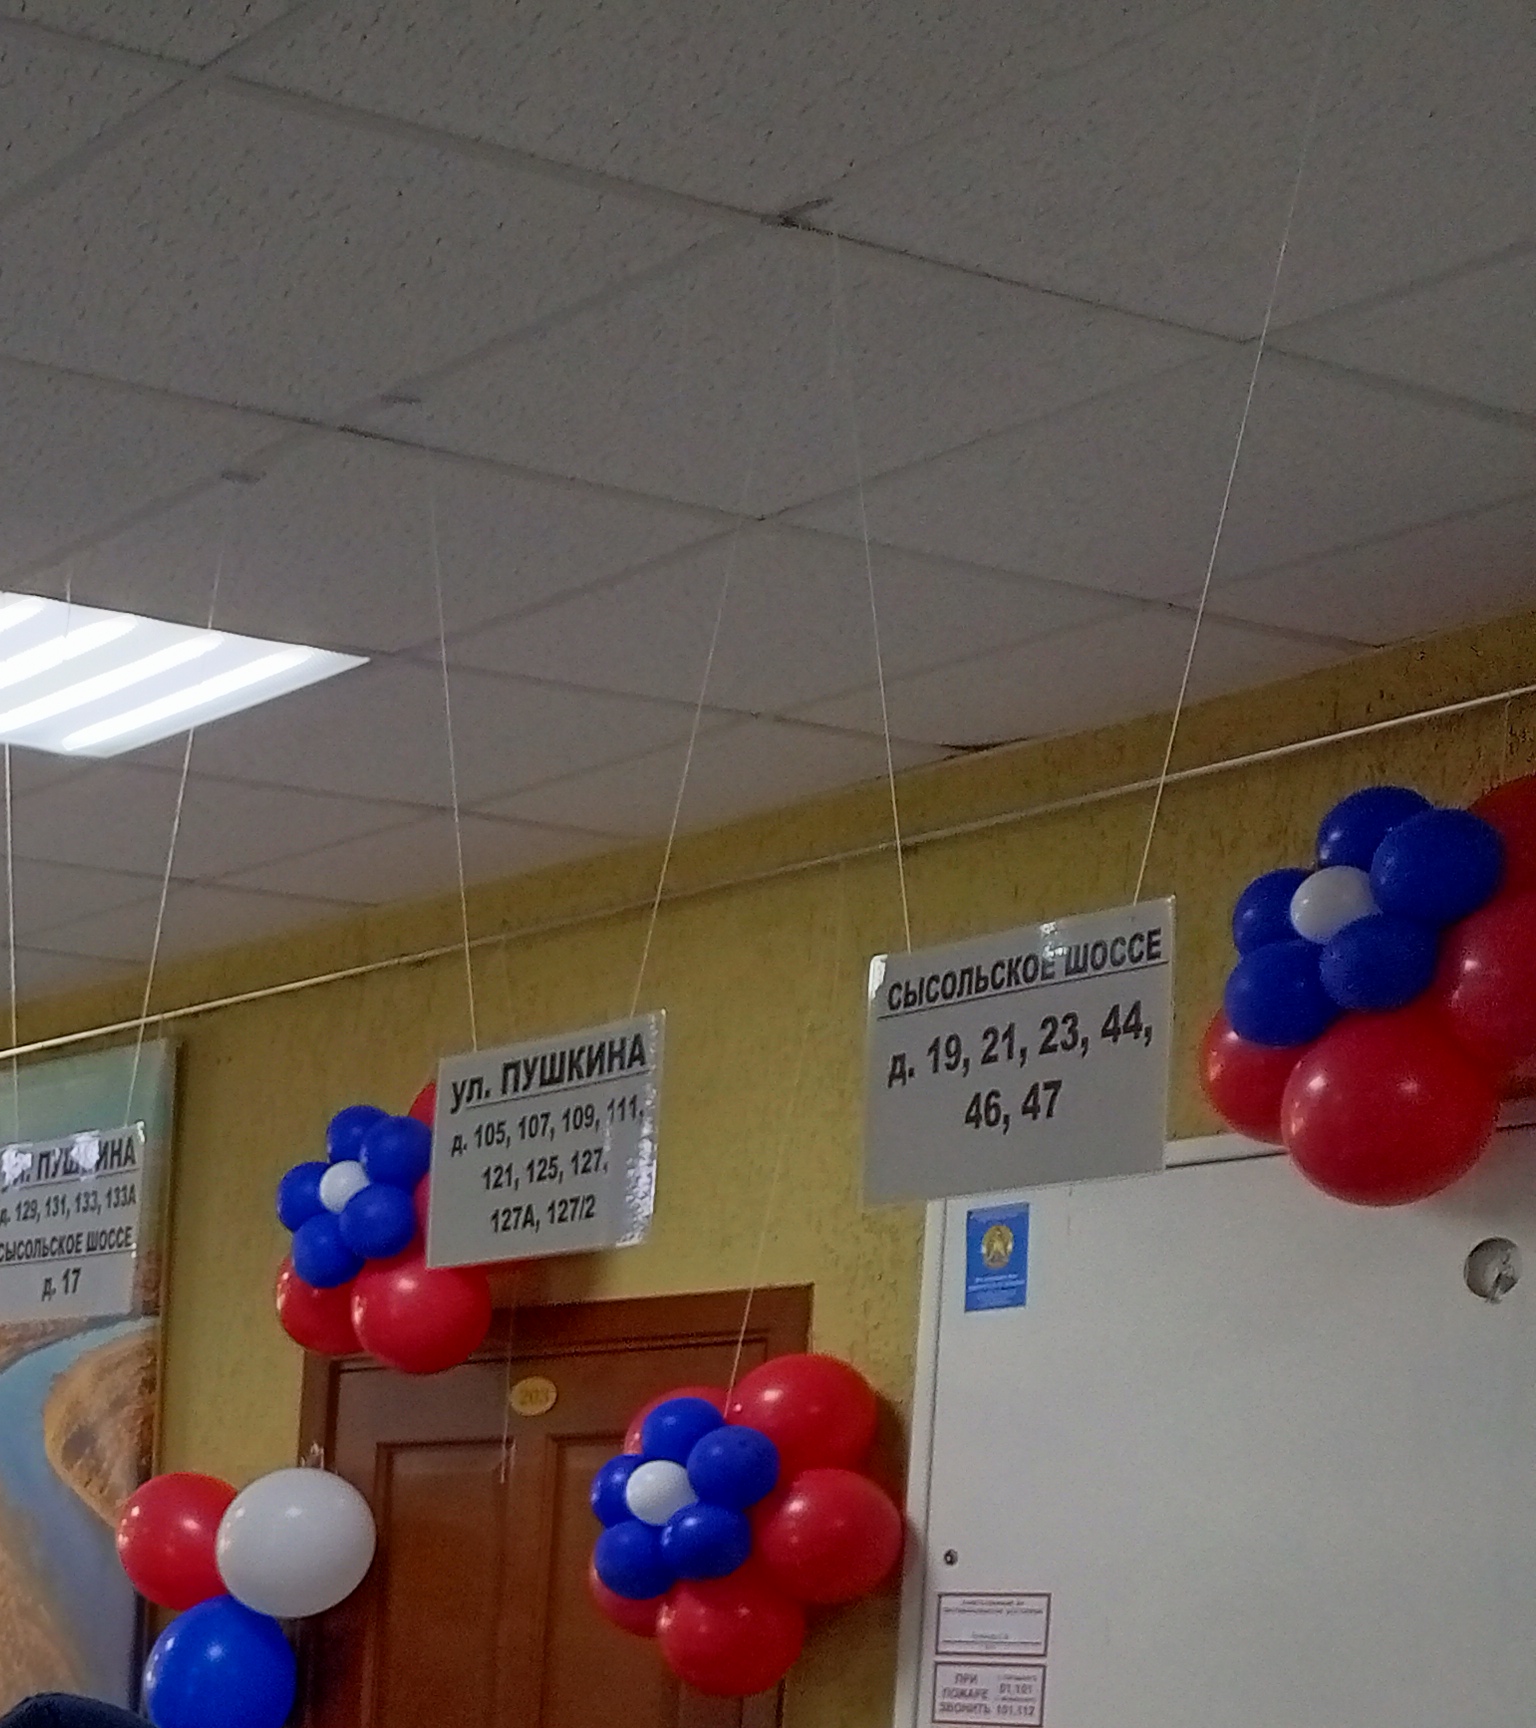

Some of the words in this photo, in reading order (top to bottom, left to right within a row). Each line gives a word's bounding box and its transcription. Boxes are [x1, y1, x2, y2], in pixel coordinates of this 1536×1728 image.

[886, 952, 1056, 1012] СЫСОЛЬСКОЕ
[1065, 926, 1163, 977] ШОССЕ
[501, 1032, 647, 1095] ПУШКИНА
[886, 1055, 916, 1089] д.
[927, 1033, 971, 1078] 19,
[981, 1022, 1028, 1069] 21,
[1039, 1011, 1090, 1058] 23,
[1101, 1000, 1154, 1047] 44,
[474, 1120, 512, 1149] 105,
[518, 1112, 556, 1141] 107,
[562, 1103, 600, 1132] 109,
[964, 1089, 1011, 1135] 46,
[1021, 1079, 1063, 1121] 47
[37, 1135, 136, 1181] ПУШИНА
[481, 1163, 520, 1192] 121,
[526, 1155, 564, 1185] 125,
[571, 1146, 609, 1174] 127,
[546, 1193, 597, 1226] 127/2
[86, 1225, 134, 1253] ШОССЕ
[62, 1266, 83, 1295] 17
